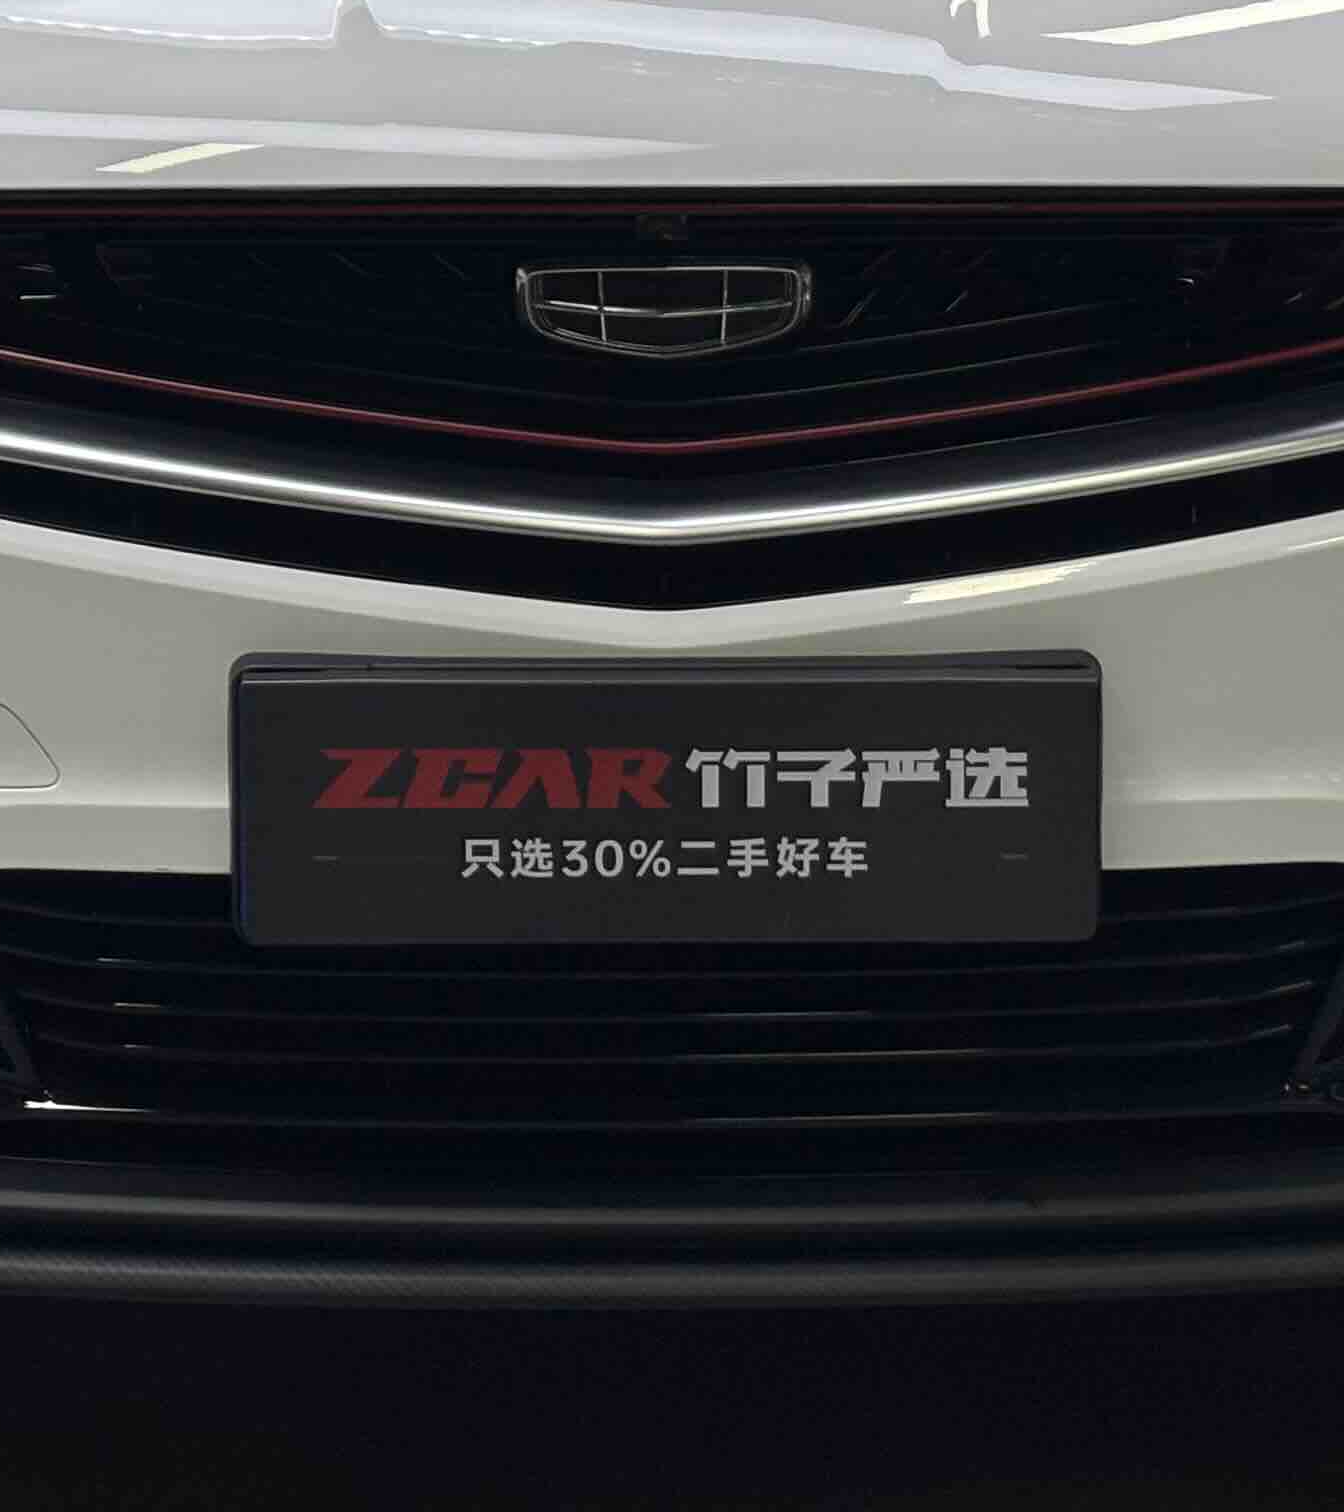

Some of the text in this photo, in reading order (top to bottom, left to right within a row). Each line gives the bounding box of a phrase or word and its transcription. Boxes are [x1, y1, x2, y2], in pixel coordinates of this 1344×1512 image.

[312, 746, 1030, 809] ZCAR 竹子严选
[460, 837, 869, 879] 只选30%二手好车
